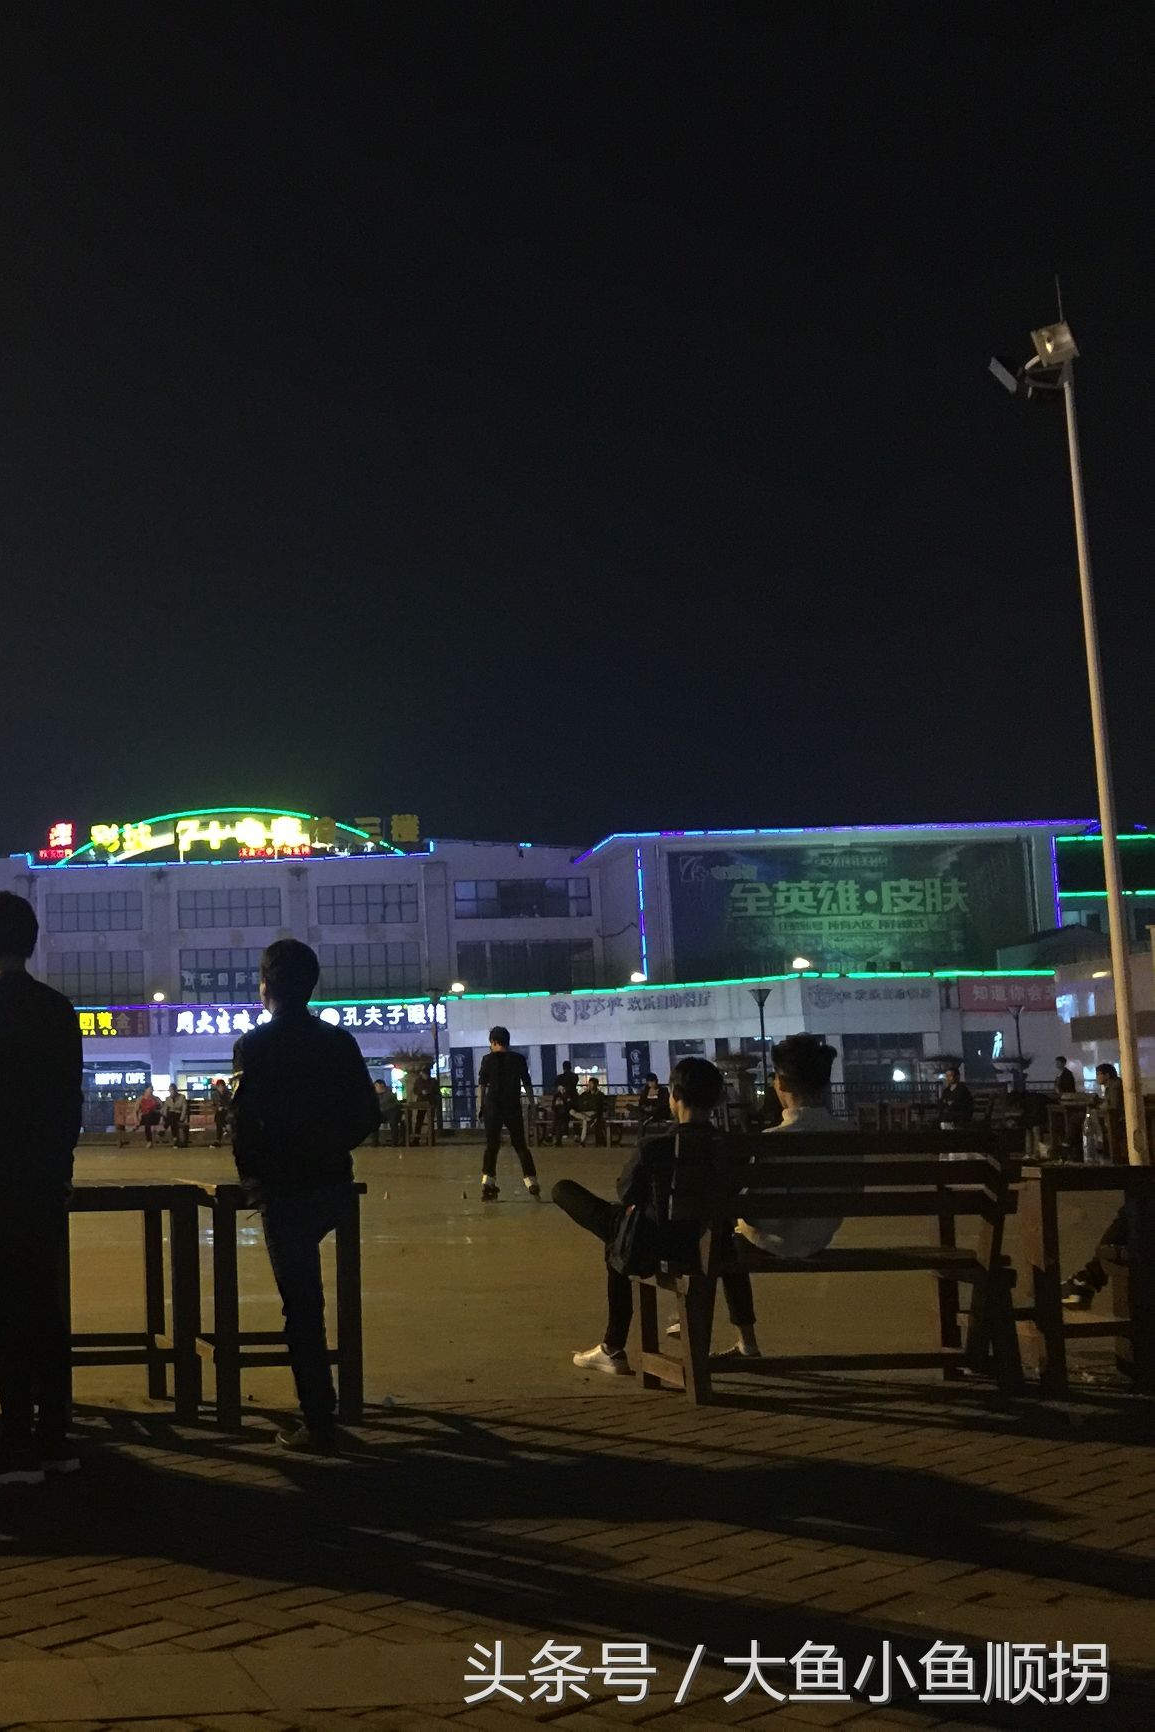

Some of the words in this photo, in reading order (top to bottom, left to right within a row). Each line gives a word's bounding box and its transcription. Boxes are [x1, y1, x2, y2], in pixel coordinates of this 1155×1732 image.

[343, 1004, 446, 1026] 孔夫子眼镜
